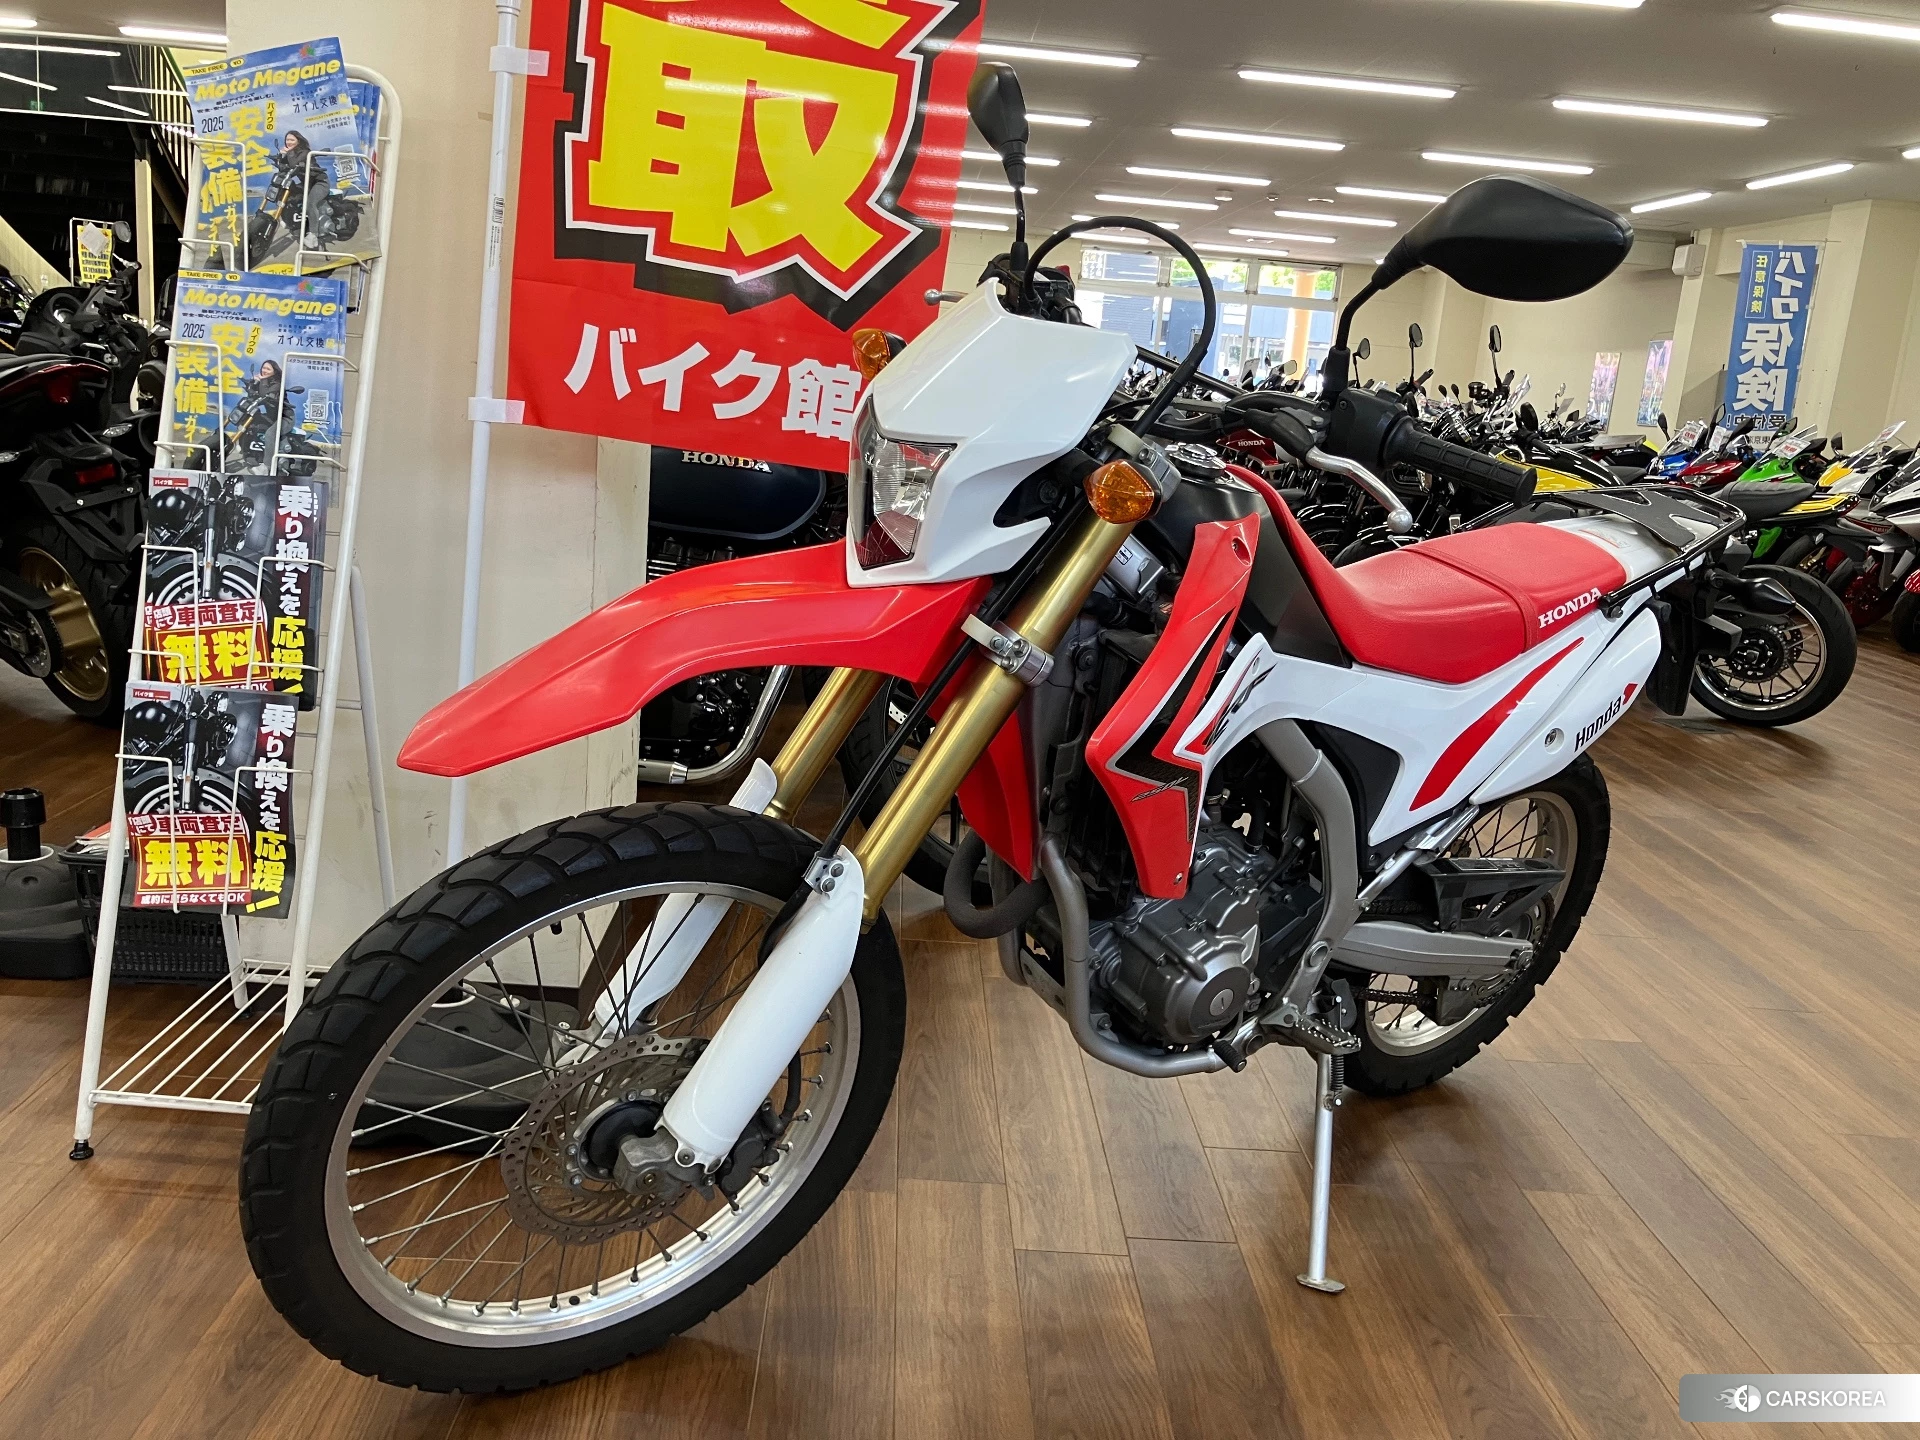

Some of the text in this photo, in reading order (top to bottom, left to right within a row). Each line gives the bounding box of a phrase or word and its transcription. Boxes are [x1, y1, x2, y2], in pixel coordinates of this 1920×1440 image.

[194, 77, 251, 103] Moto
[252, 59, 341, 89] Megane
[208, 64, 225, 72] FREE
[201, 115, 224, 134] 2025
[266, 102, 276, 130] バイクの
[229, 106, 273, 177] 安全
[588, 0, 914, 273] 取
[182, 287, 242, 308] Moto
[242, 292, 338, 317] Megane
[182, 323, 206, 339] 2025
[246, 326, 261, 354] バイクの
[209, 321, 245, 395] 安全
[564, 323, 862, 442] バイク館
[1237, 438, 1266, 448] HONDA
[681, 450, 773, 474] HONDA
[177, 601, 262, 627] 車両査定
[1537, 587, 1602, 629] HONDA
[162, 628, 262, 682] 無料
[1574, 695, 1622, 753] Honda
[156, 815, 244, 835] 車両査定
[246, 703, 296, 913] 乗り換えを応援!
[144, 839, 245, 887] 無料
